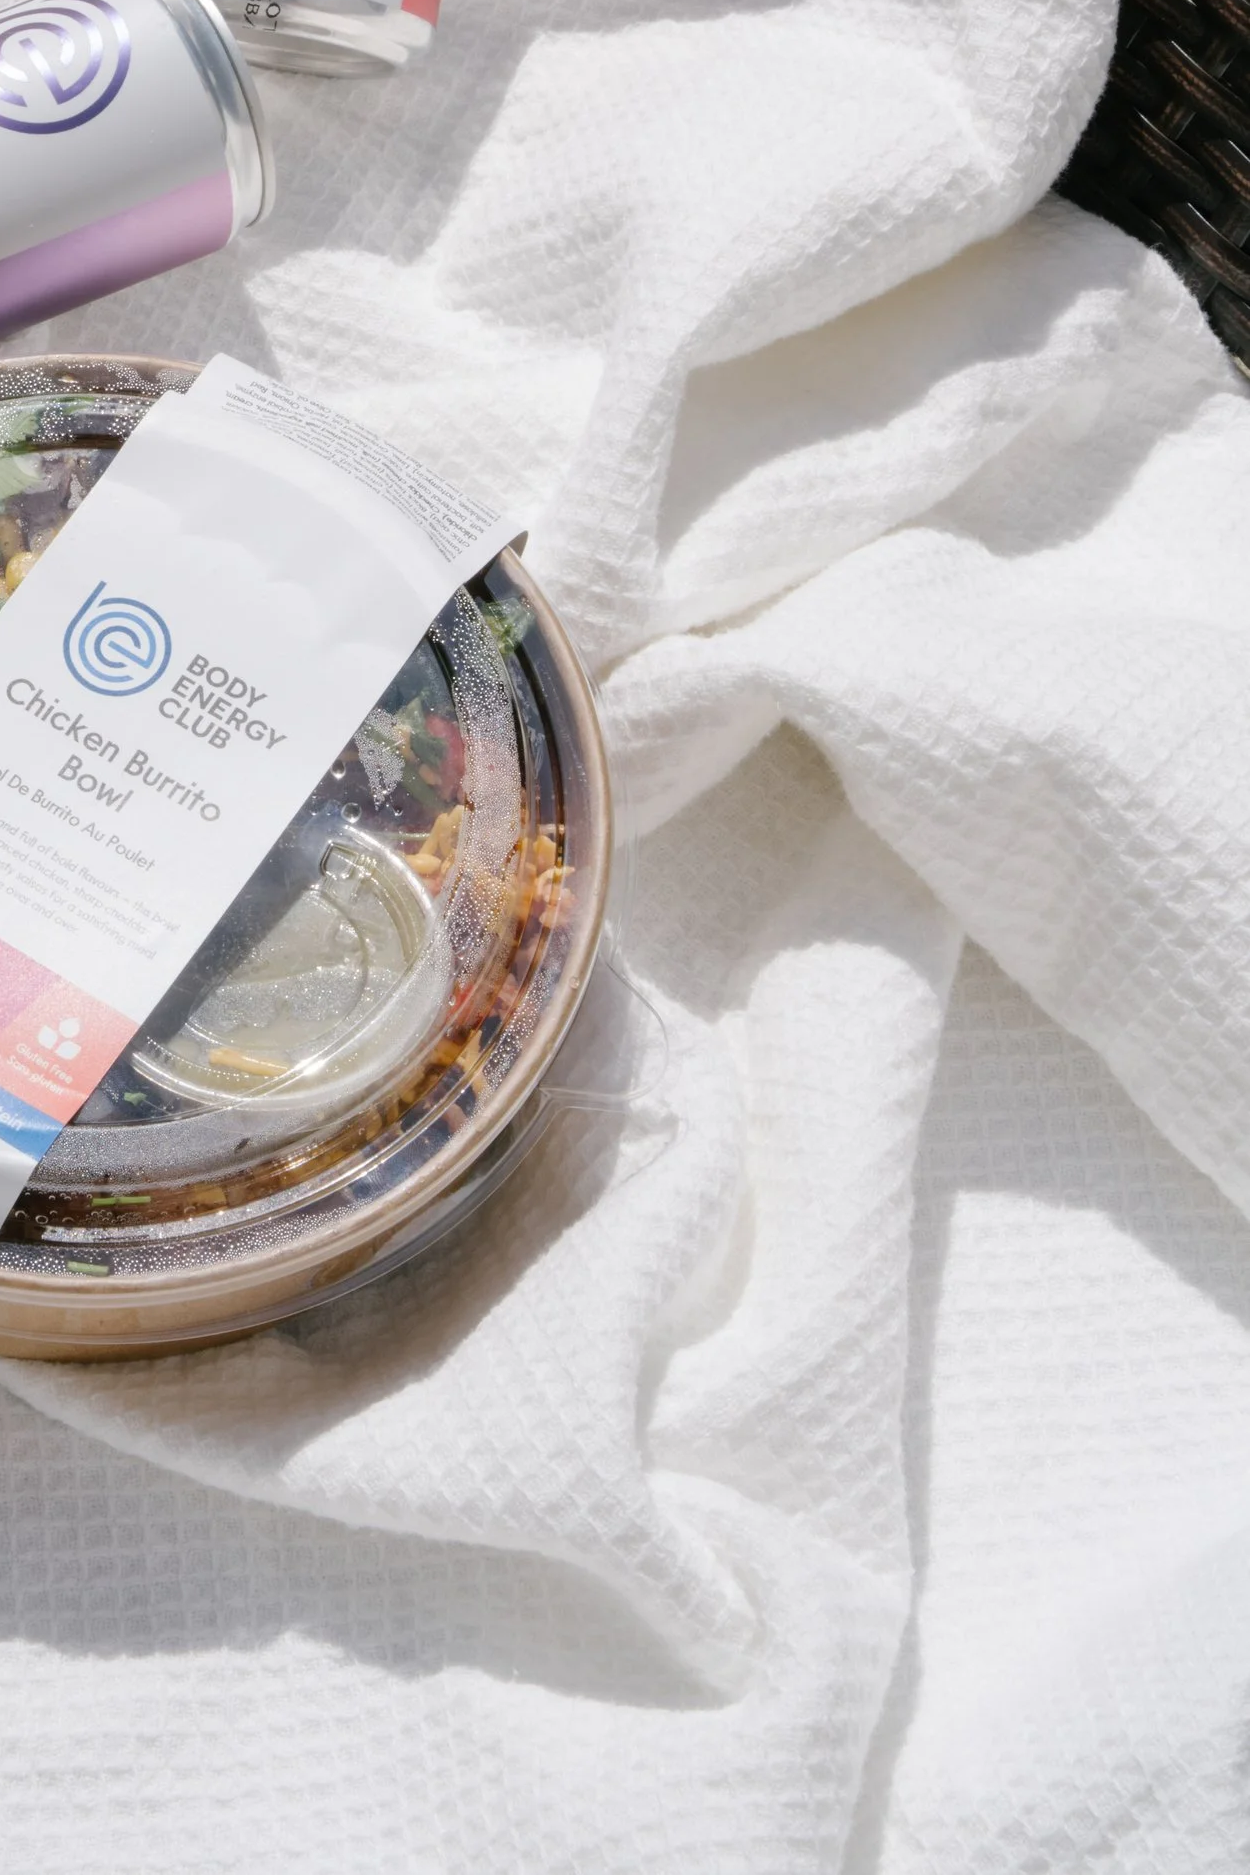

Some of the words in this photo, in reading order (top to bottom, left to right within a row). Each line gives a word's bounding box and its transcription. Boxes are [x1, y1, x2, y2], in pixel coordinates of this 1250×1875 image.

[171, 674, 288, 750] ENERGY
[186, 653, 268, 709] BODY
[5, 678, 122, 763] Chicken
[123, 749, 222, 823] Burrito
[158, 697, 232, 750] CLUB
[57, 754, 135, 813] Bowl
[7, 774, 30, 796] De
[29, 788, 82, 828] Burrito
[80, 821, 107, 842] Au
[105, 833, 156, 873] Poulet
[18, 827, 39, 849] full
[37, 841, 50, 856] of
[50, 847, 79, 873] bold
[78, 865, 121, 900] flavours
[26, 851, 71, 894] chicken,
[72, 884, 102, 914] sharp
[5, 884, 32, 906] over
[30, 898, 56, 921] and
[16, 866, 49, 895] salsas
[48, 885, 66, 906] for
[66, 903, 76, 913] a
[75, 906, 126, 951] satisfying
[16, 1042, 51, 1070] Gluten
[49, 1062, 73, 1085] Free
